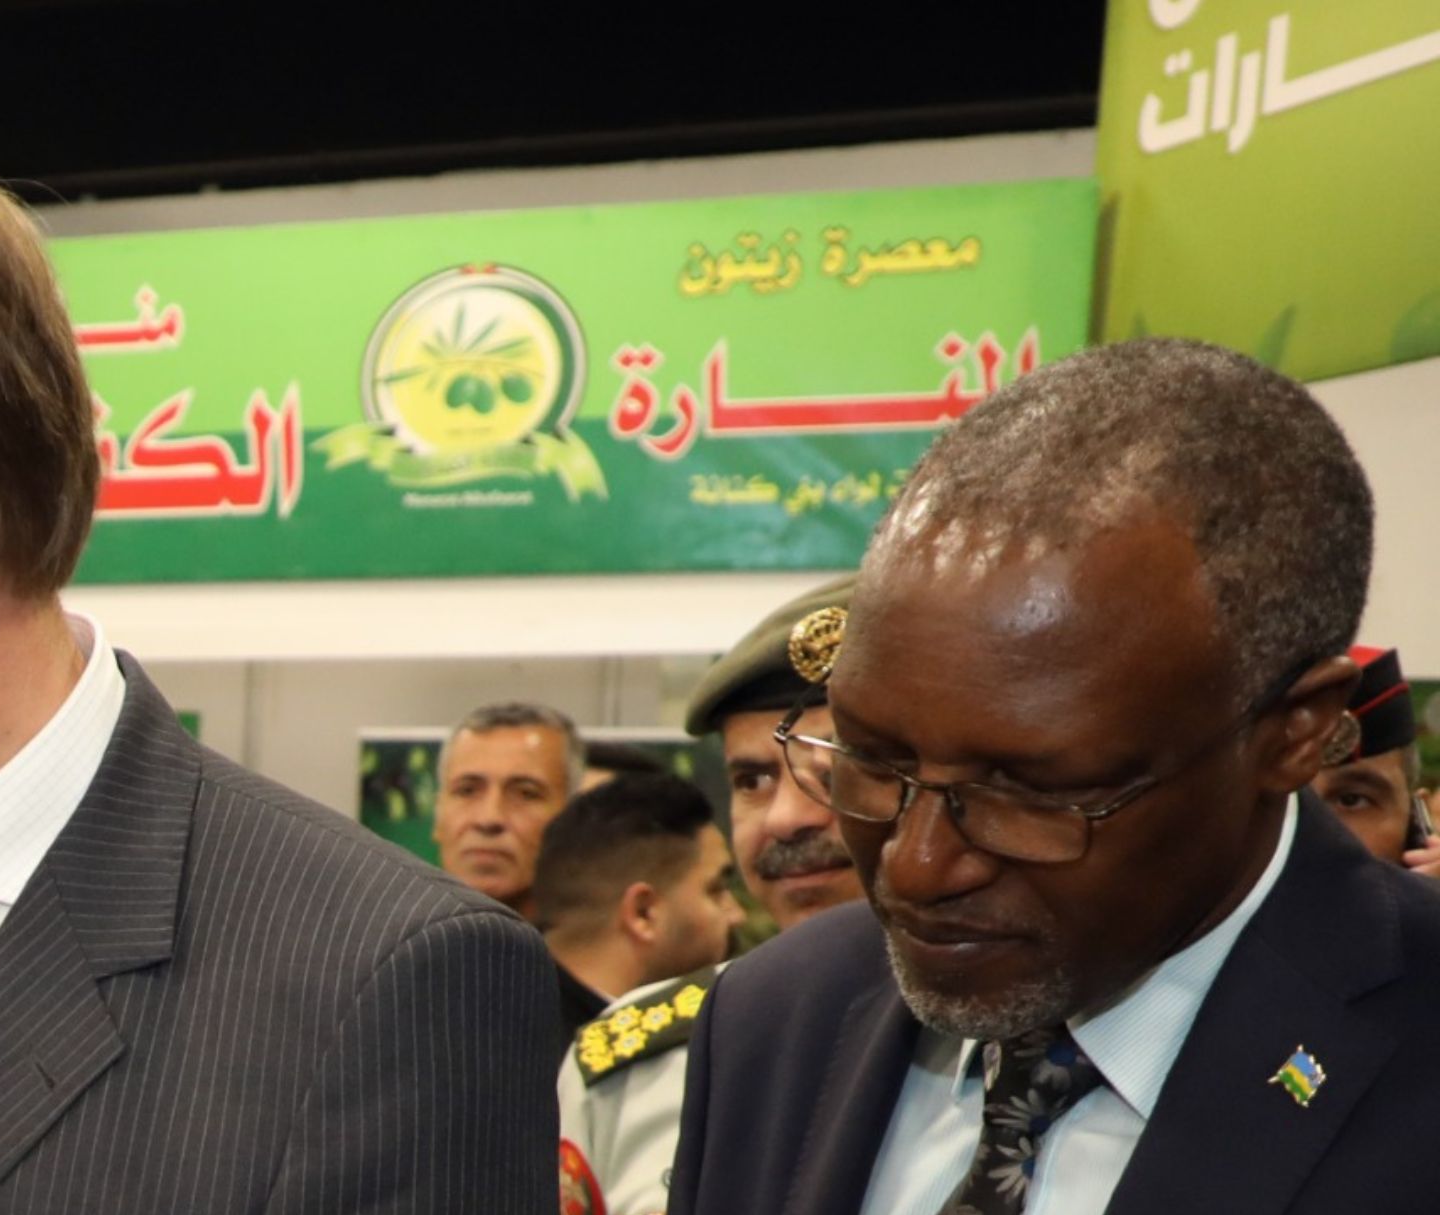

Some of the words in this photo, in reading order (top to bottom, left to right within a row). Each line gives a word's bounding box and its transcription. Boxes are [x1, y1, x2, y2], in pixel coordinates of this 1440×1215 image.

[1138, 12, 1440, 154] ارات
[676, 226, 803, 296] زيتون
[820, 226, 982, 288] معصرة
